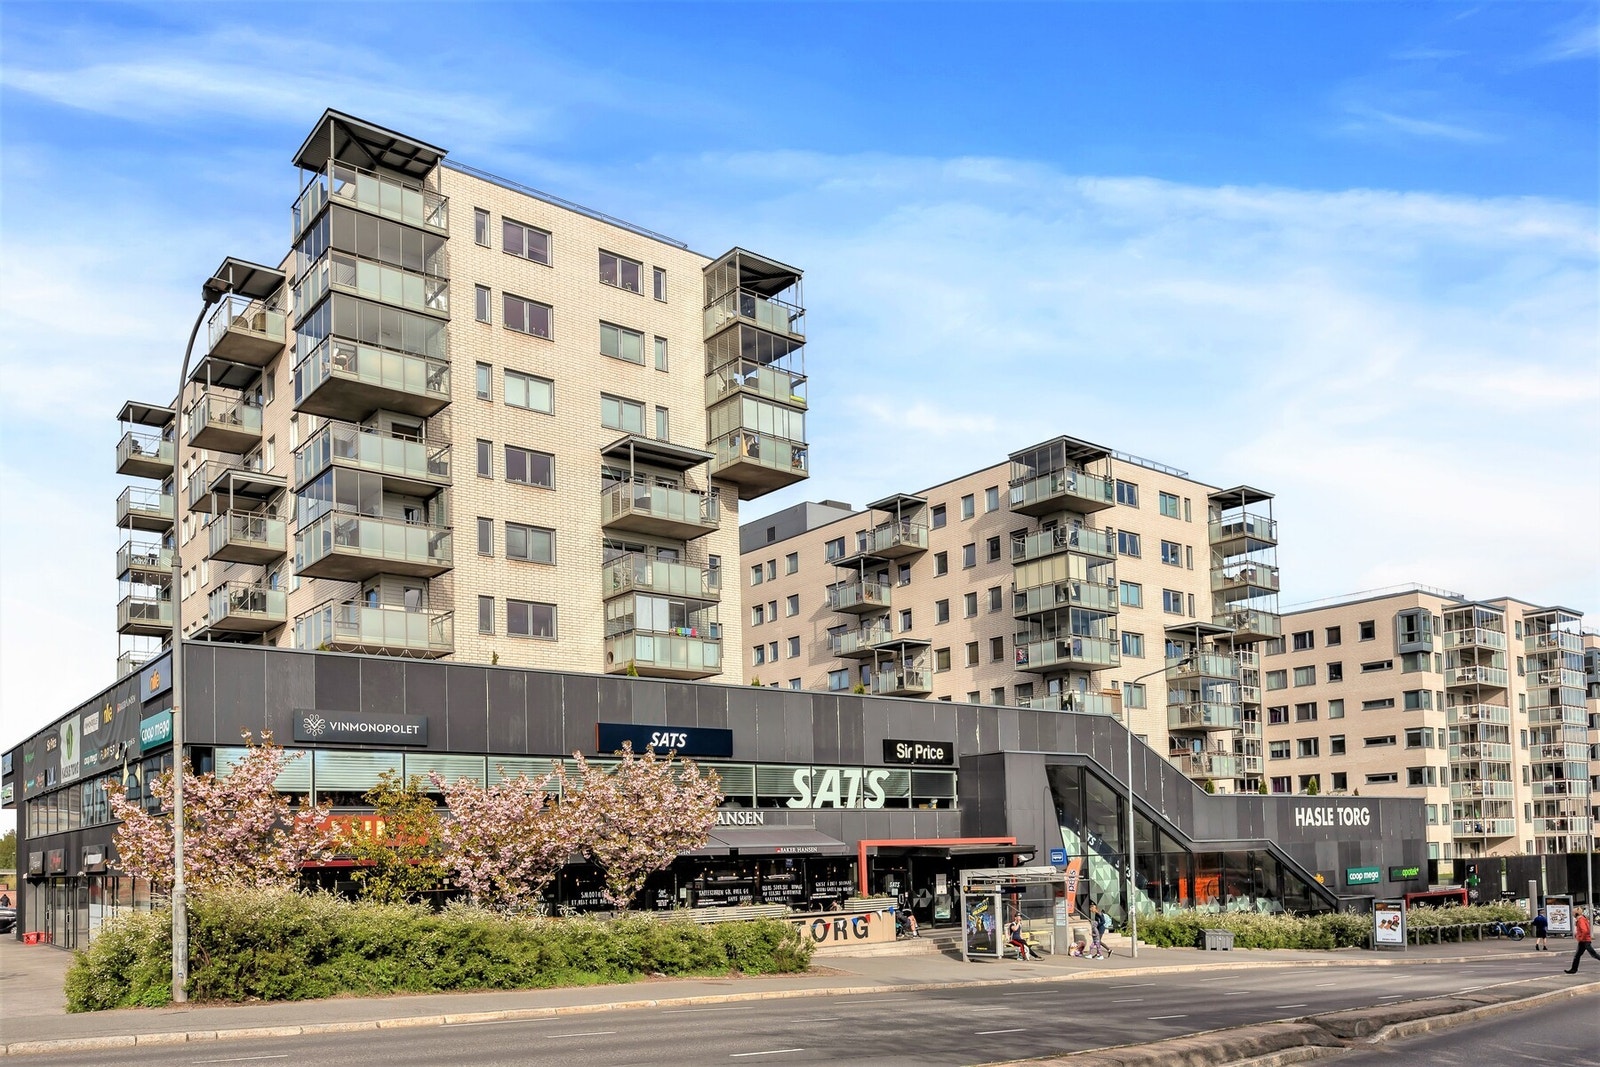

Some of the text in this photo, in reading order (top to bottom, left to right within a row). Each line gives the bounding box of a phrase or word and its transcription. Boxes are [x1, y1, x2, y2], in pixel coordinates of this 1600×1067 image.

[141, 719, 170, 742] coop mega
[329, 721, 419, 734] VINMONOPOLET
[649, 731, 688, 748] SATS
[896, 743, 944, 760] Sir Price
[785, 769, 890, 809] SATS
[715, 811, 764, 825] ANSEN
[1295, 806, 1371, 826] HASLE TORG
[1349, 871, 1379, 881] coop mega
